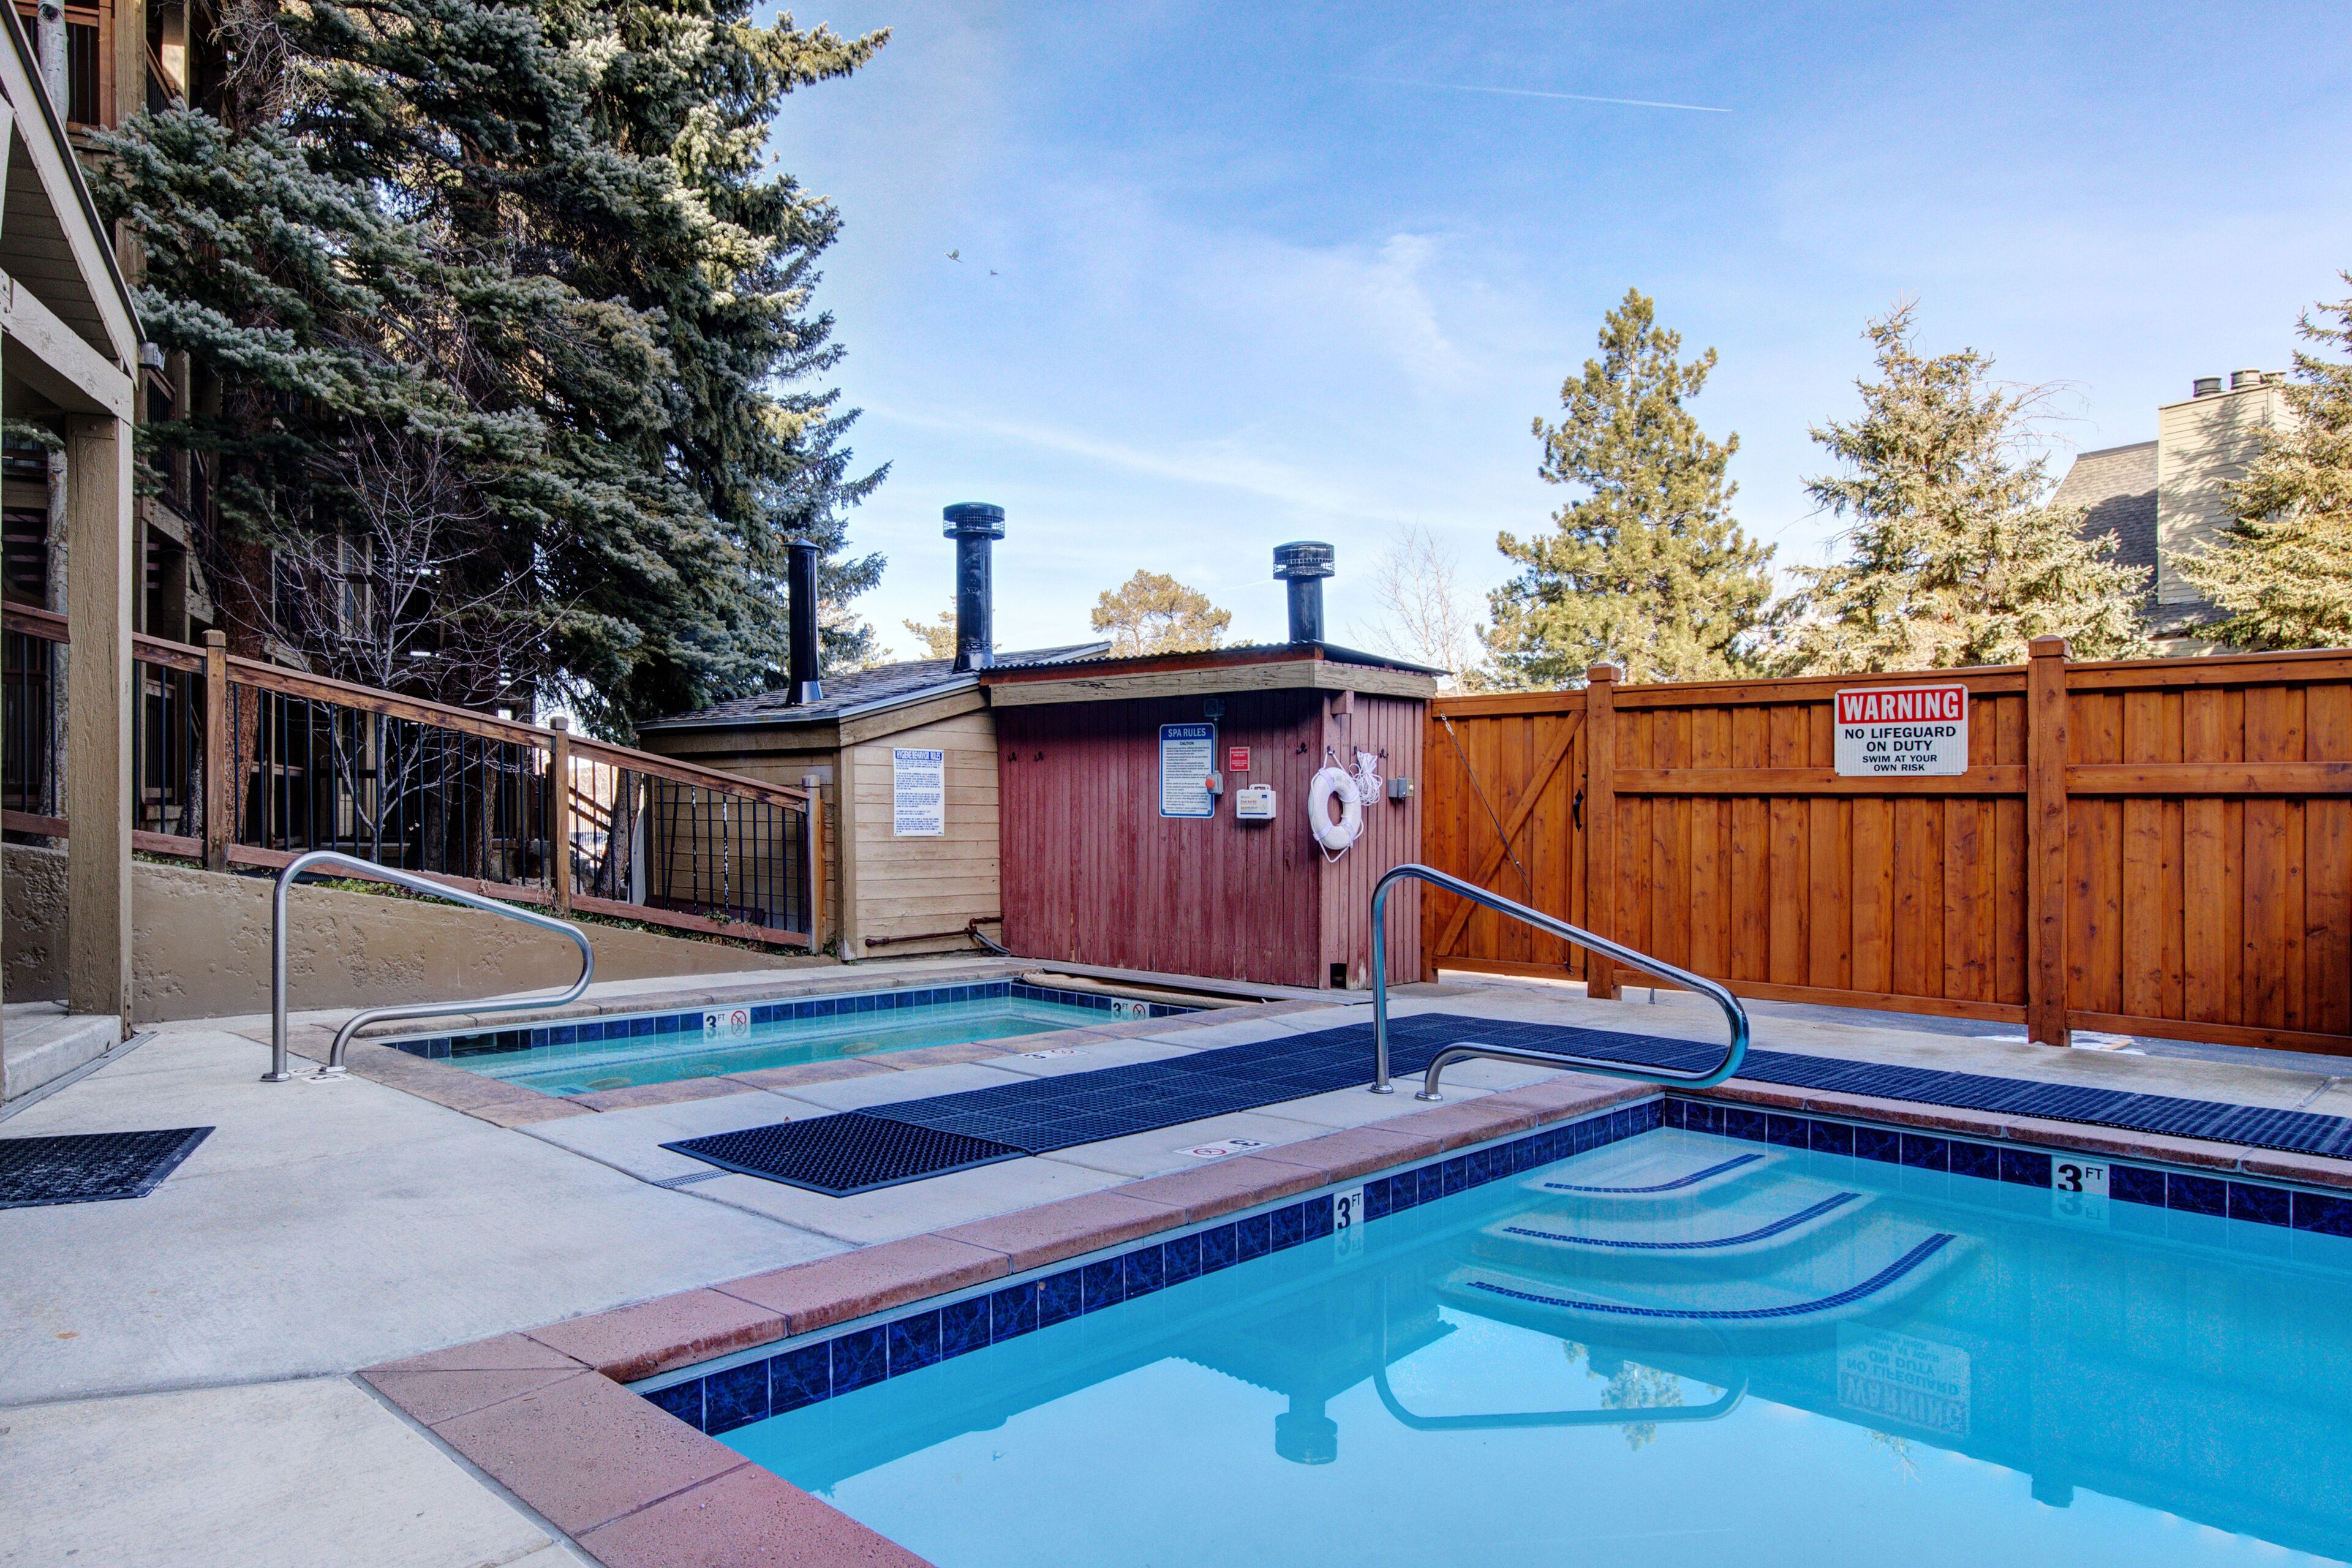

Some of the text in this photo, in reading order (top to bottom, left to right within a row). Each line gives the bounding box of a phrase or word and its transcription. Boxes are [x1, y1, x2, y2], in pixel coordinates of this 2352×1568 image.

[1843, 691, 1959, 721] WARNING
[1168, 728, 1206, 737] SPA RULES
[1845, 726, 1956, 739] NO LIFEGUARD
[1866, 740, 1932, 752] ON DUTY
[930, 752, 941, 760] RULES
[1863, 755, 1891, 763] SWIM
[1113, 1003, 1121, 1012] 3
[706, 1015, 717, 1028] 3
[2058, 1164, 2103, 1192] 3 FT
[1338, 1193, 1361, 1229] 3 FT
